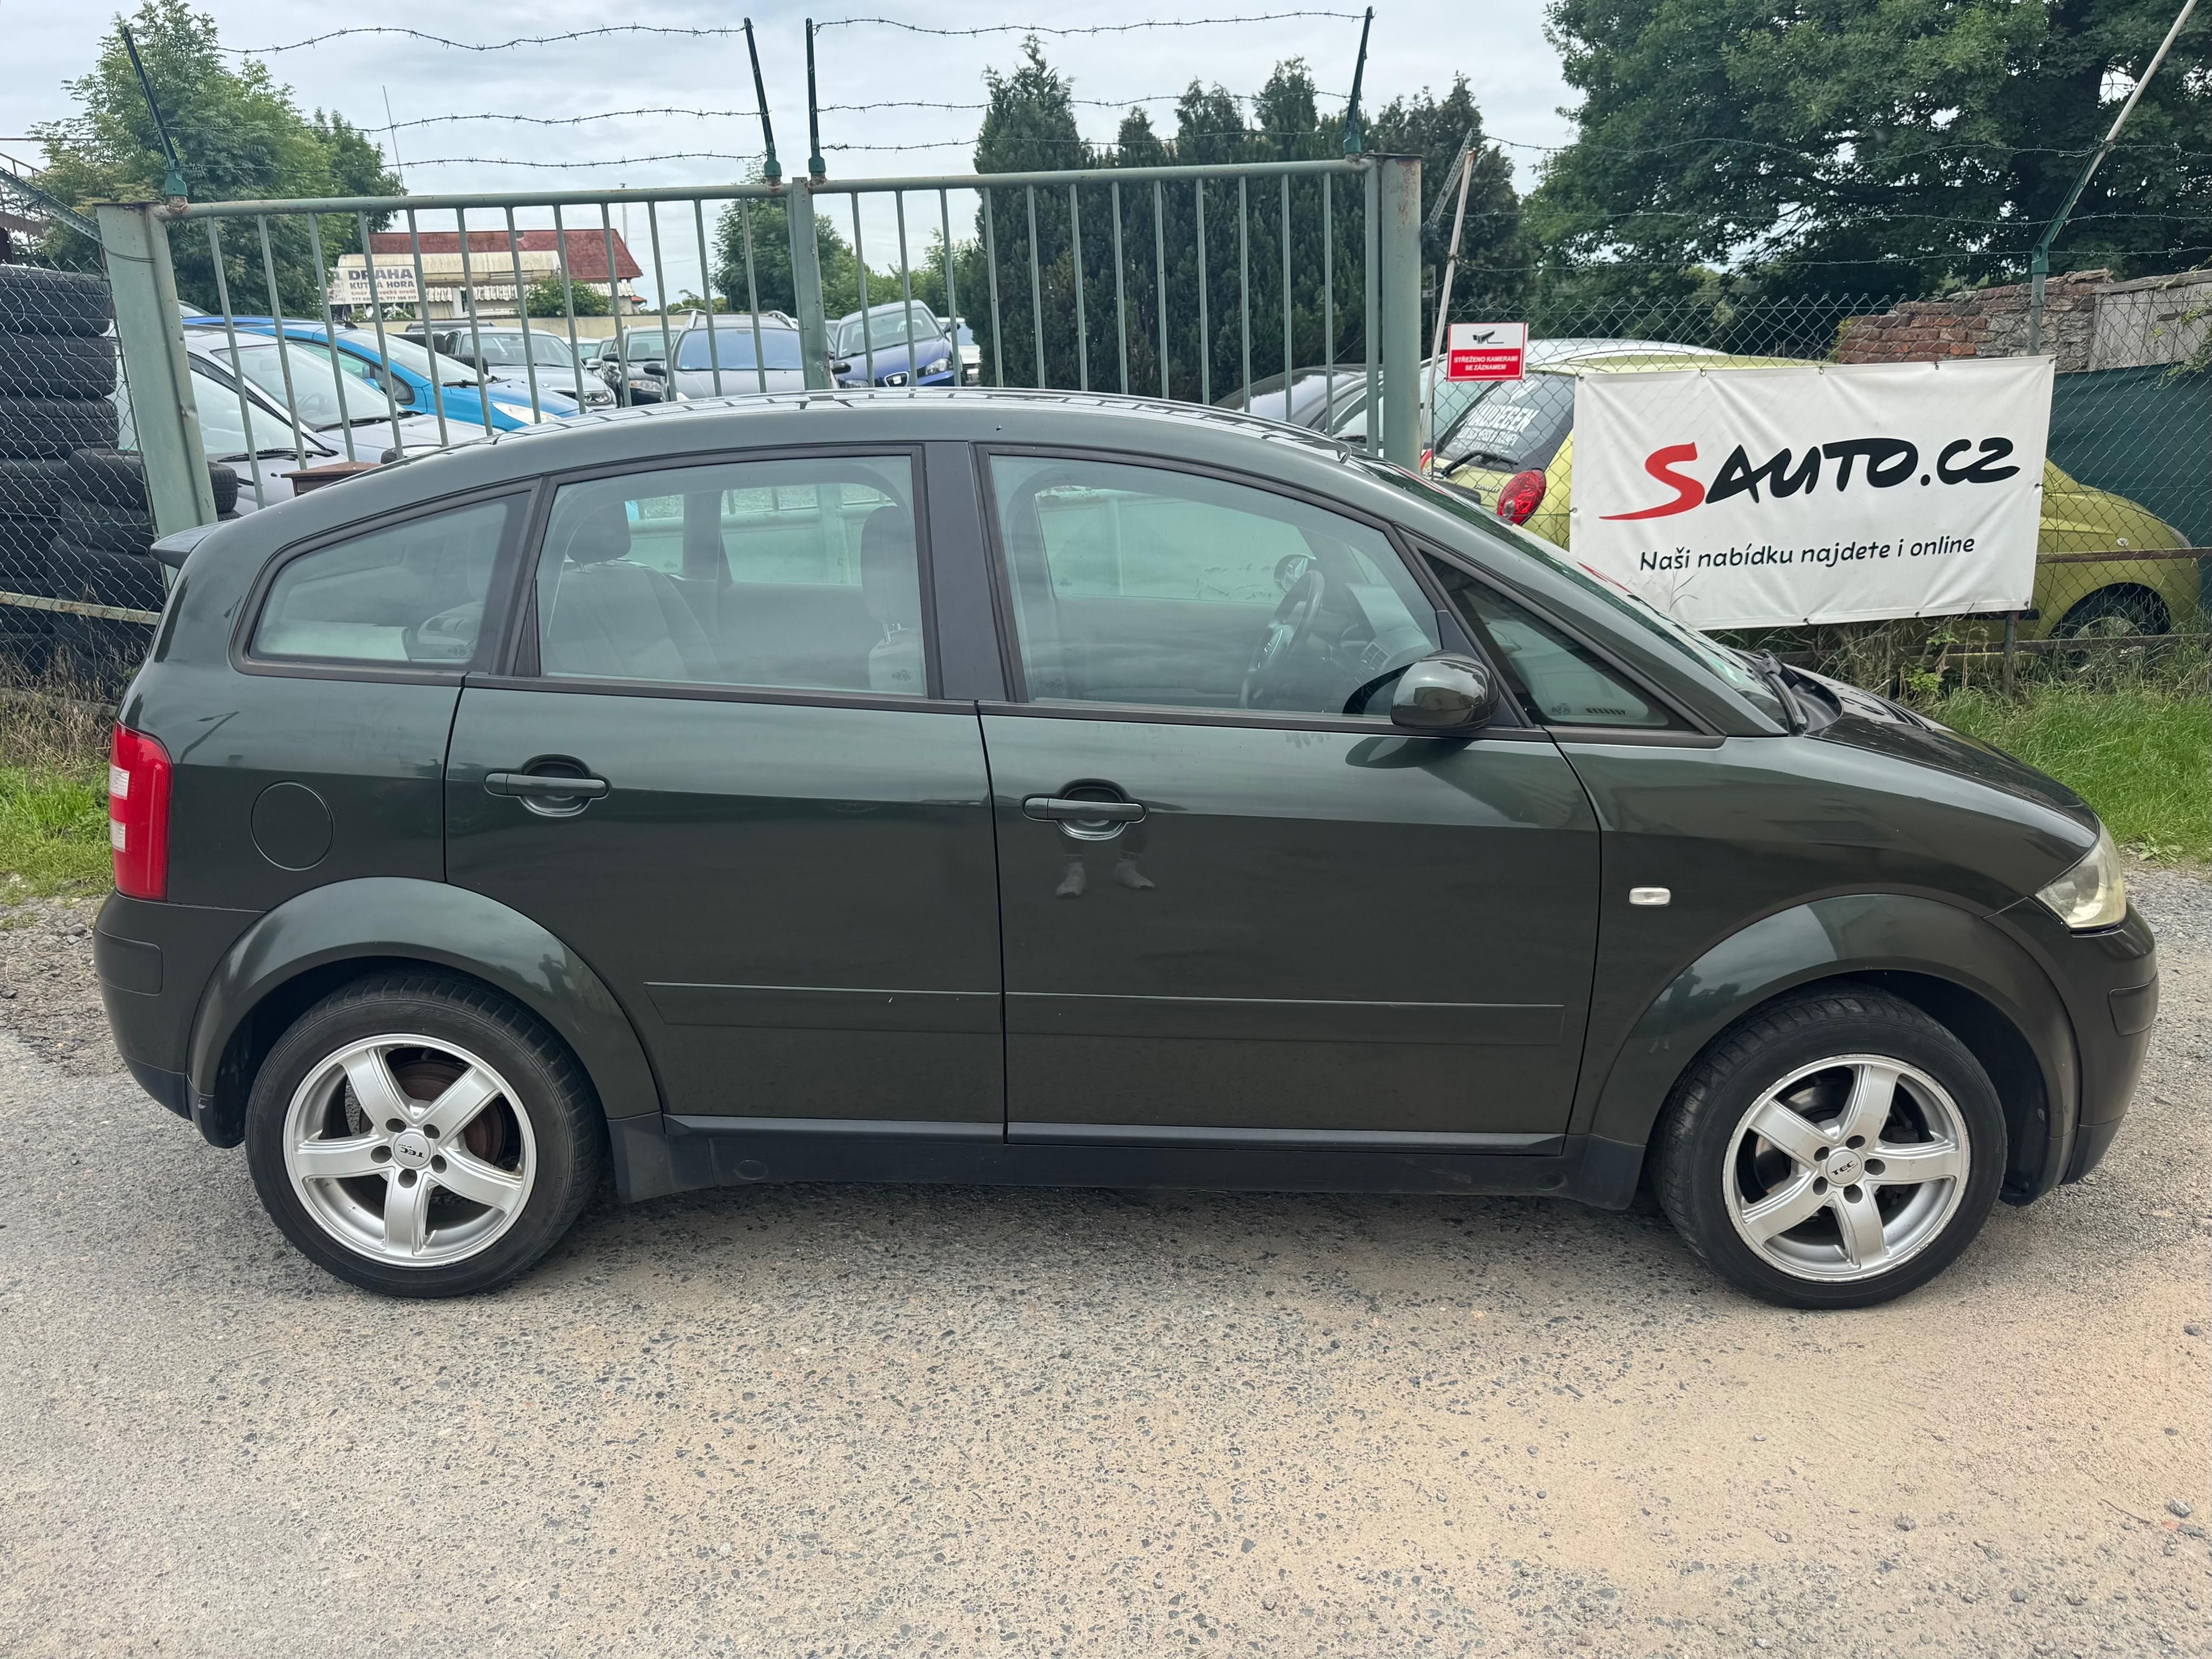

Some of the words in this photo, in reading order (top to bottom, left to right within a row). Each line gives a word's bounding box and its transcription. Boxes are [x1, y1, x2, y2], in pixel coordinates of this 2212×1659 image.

[1640, 547, 1689, 571] Naši
[1698, 543, 1793, 568] nabídku
[1801, 541, 1890, 568] najdete
[1898, 538, 1904, 557] i
[1910, 535, 1974, 556] online
[400, 1147, 424, 1158] TEC
[1831, 1160, 1855, 1175] TEC
